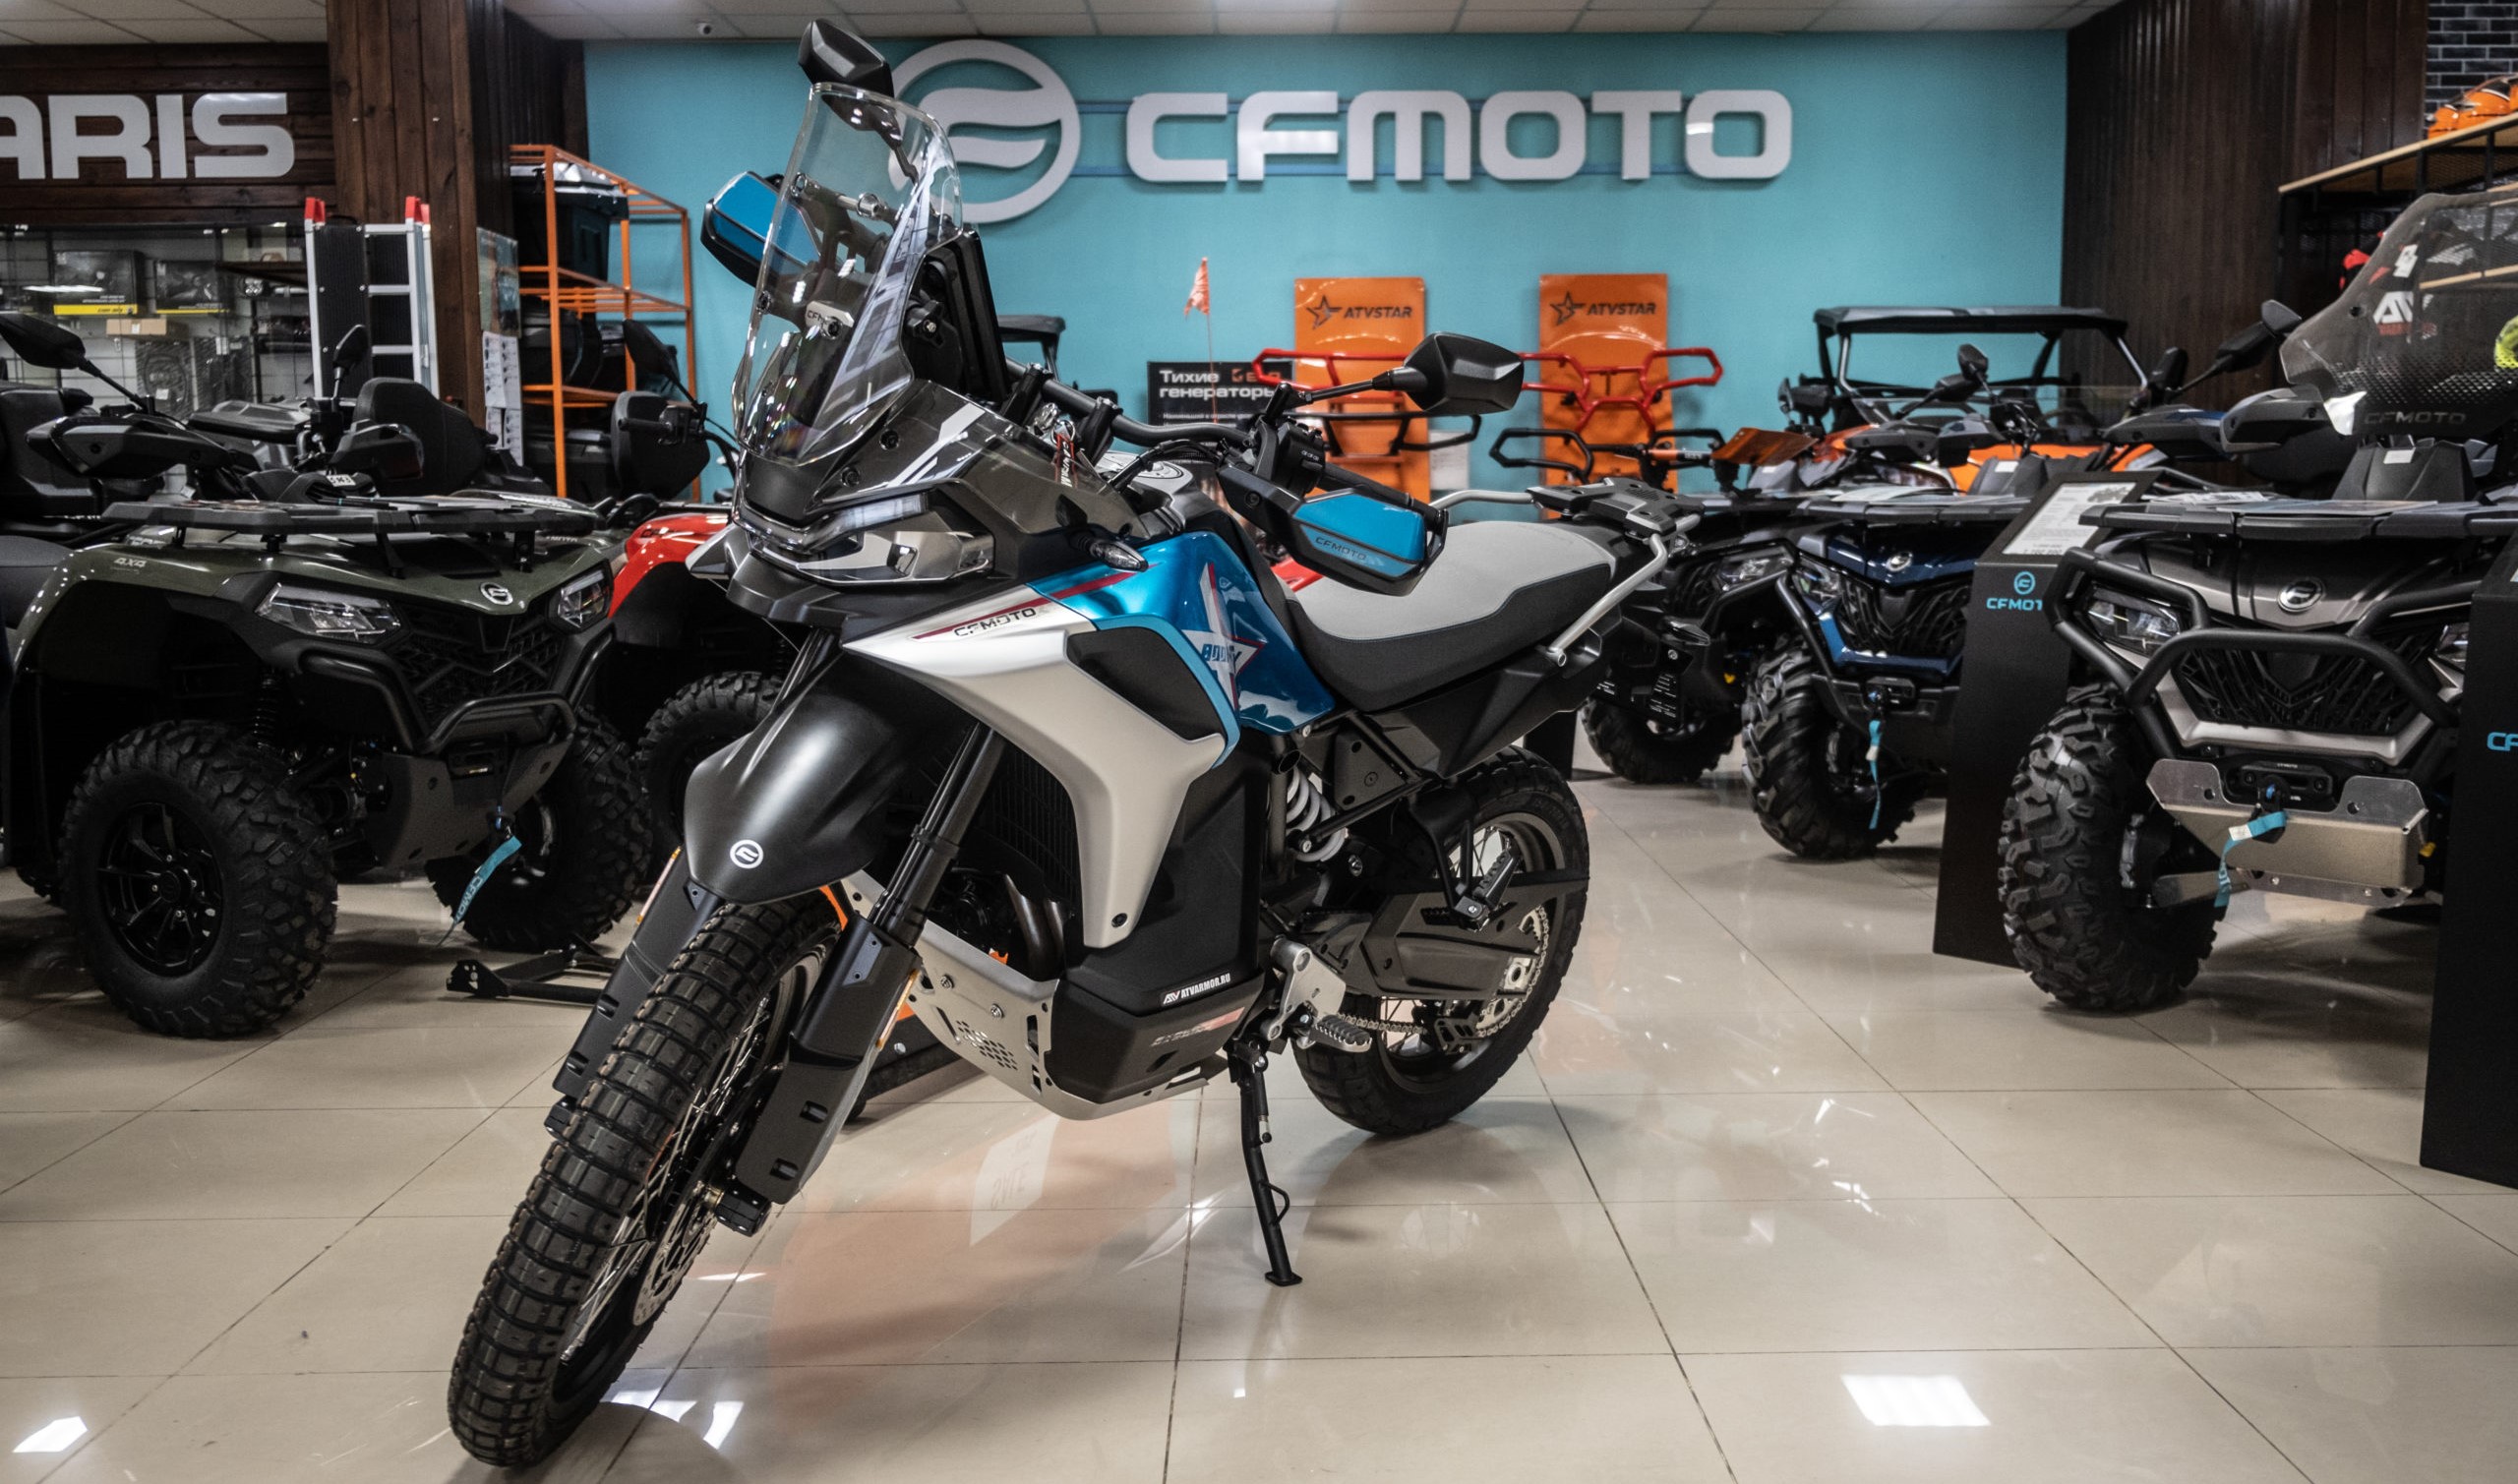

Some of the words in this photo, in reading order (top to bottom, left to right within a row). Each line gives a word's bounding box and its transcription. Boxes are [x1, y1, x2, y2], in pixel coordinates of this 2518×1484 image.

[1126, 89, 1792, 181] CFMOTO
[1344, 306, 1412, 319] ATVSTAR
[1586, 302, 1656, 316] ATVSTAR
[1159, 370, 1220, 384] Тихие
[2364, 411, 2467, 424] CFMOTO
[1315, 536, 1367, 561] CFMOTO
[953, 608, 1037, 637] CFMOTO
[1180, 972, 1231, 999] ATVARMOR.RU
